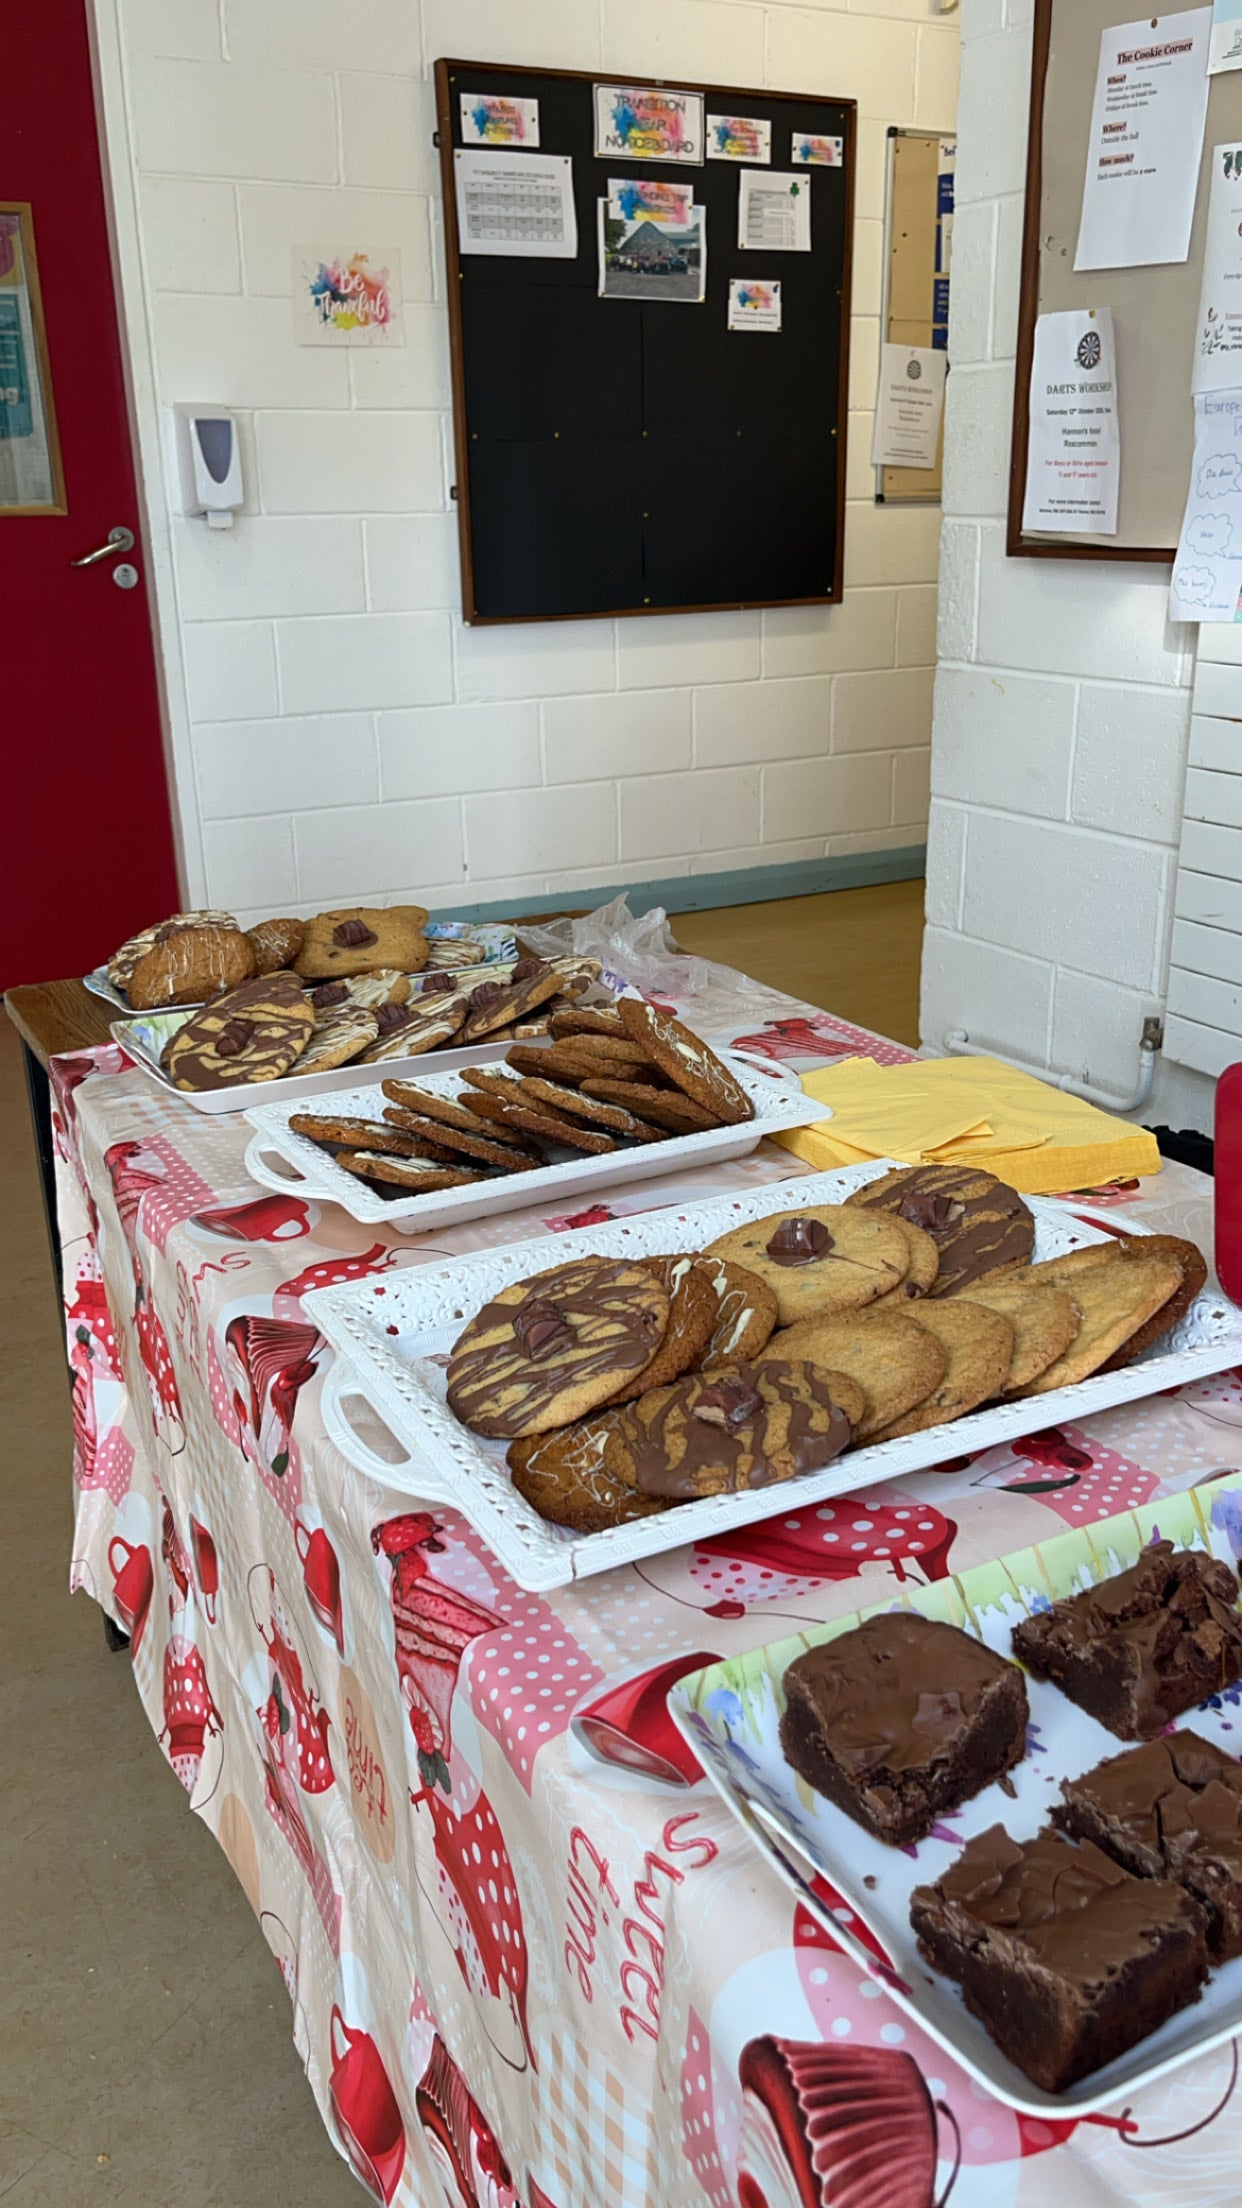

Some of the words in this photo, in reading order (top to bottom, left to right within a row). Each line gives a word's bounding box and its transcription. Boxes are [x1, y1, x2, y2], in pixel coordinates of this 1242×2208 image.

[1117, 52, 1132, 65] The
[1134, 46, 1162, 61] Cookie
[1164, 41, 1193, 55] Corner
[1107, 75, 1127, 85] When?
[613, 94, 687, 114] TRANSITION
[1103, 121, 1127, 134] Where?
[605, 134, 695, 154] NOTICEBOARD
[1113, 153, 1135, 165] much?
[336, 267, 366, 294] Be
[1046, 383, 1077, 395] DARTS
[1046, 408, 1068, 417] Saturday
[1062, 427, 1088, 435] Hannon's
[564, 1825, 621, 2004] time
